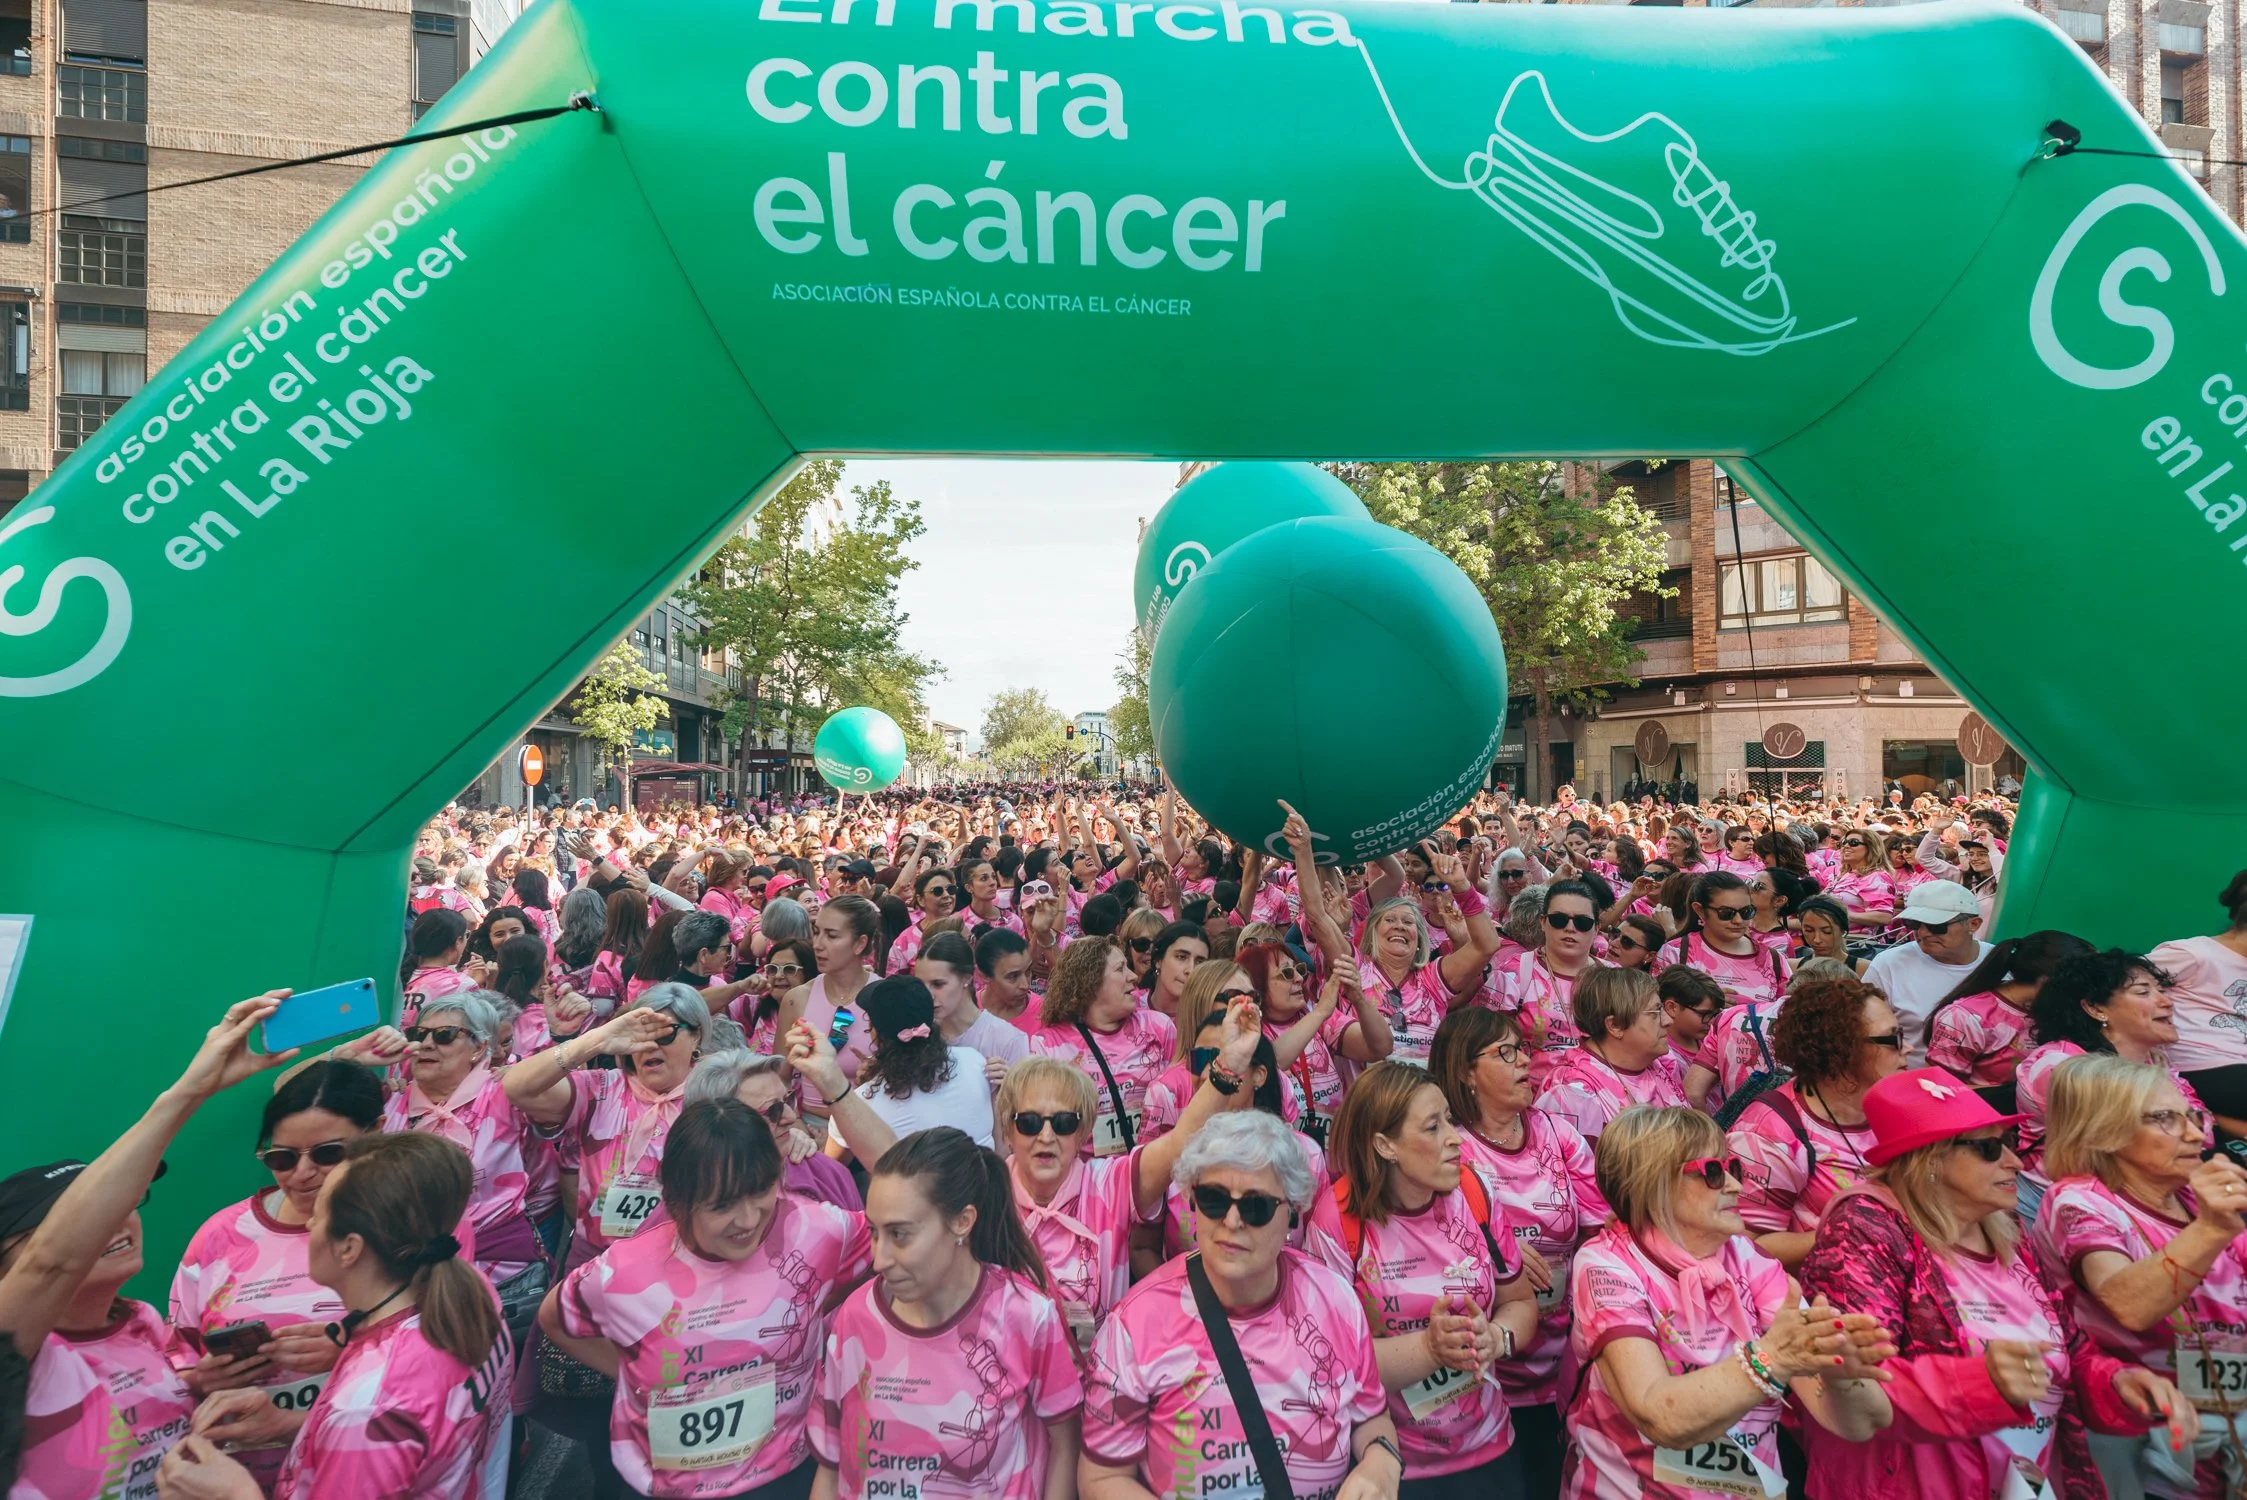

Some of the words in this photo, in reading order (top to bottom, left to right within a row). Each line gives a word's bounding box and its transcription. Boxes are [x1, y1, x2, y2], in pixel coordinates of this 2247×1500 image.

[933, 0, 1357, 47] marcha
[746, 51, 1127, 140] contra
[753, 152, 869, 256] el
[892, 160, 1287, 272] cáncer
[95, 290, 318, 484] asociación
[320, 124, 517, 289] española
[772, 281, 893, 304] ASOCIACIÓN
[898, 286, 1000, 309] ESPAÑOLA
[1004, 293, 1083, 313] CONTRA
[1088, 297, 1110, 314] EL
[1115, 293, 1191, 316] CÁNCER
[122, 398, 270, 524] contra
[268, 351, 323, 403] el
[315, 227, 469, 365] cáncer
[164, 508, 241, 571] en
[219, 456, 309, 519] La
[287, 351, 434, 465] Rioja
[2141, 416, 2204, 479] en
[2184, 461, 2247, 533] La
[1351, 783, 1455, 840] asociación
[1458, 707, 1505, 784] española
[1353, 821, 1419, 851] contra
[1423, 807, 1440, 822] el
[1356, 848, 1381, 860] en
[1386, 836, 1410, 851] La
[1394, 1034, 1433, 1046] stigació
[1590, 1269, 1609, 1277] DRA
[1382, 1295, 1400, 1313] XI
[1593, 1288, 1617, 1298] RUIZ
[1386, 1316, 1431, 1331] Carre
[684, 1344, 703, 1366] XI
[683, 1360, 759, 1386] Carrera
[680, 1399, 744, 1447] 897
[868, 1419, 885, 1441] XI
[1200, 1407, 1222, 1430] XI
[867, 1449, 939, 1472] Carrera
[1201, 1436, 1288, 1461] Carra
[867, 1480, 896, 1500] por
[901, 1478, 918, 1500] la
[1202, 1473, 1240, 1496] por
